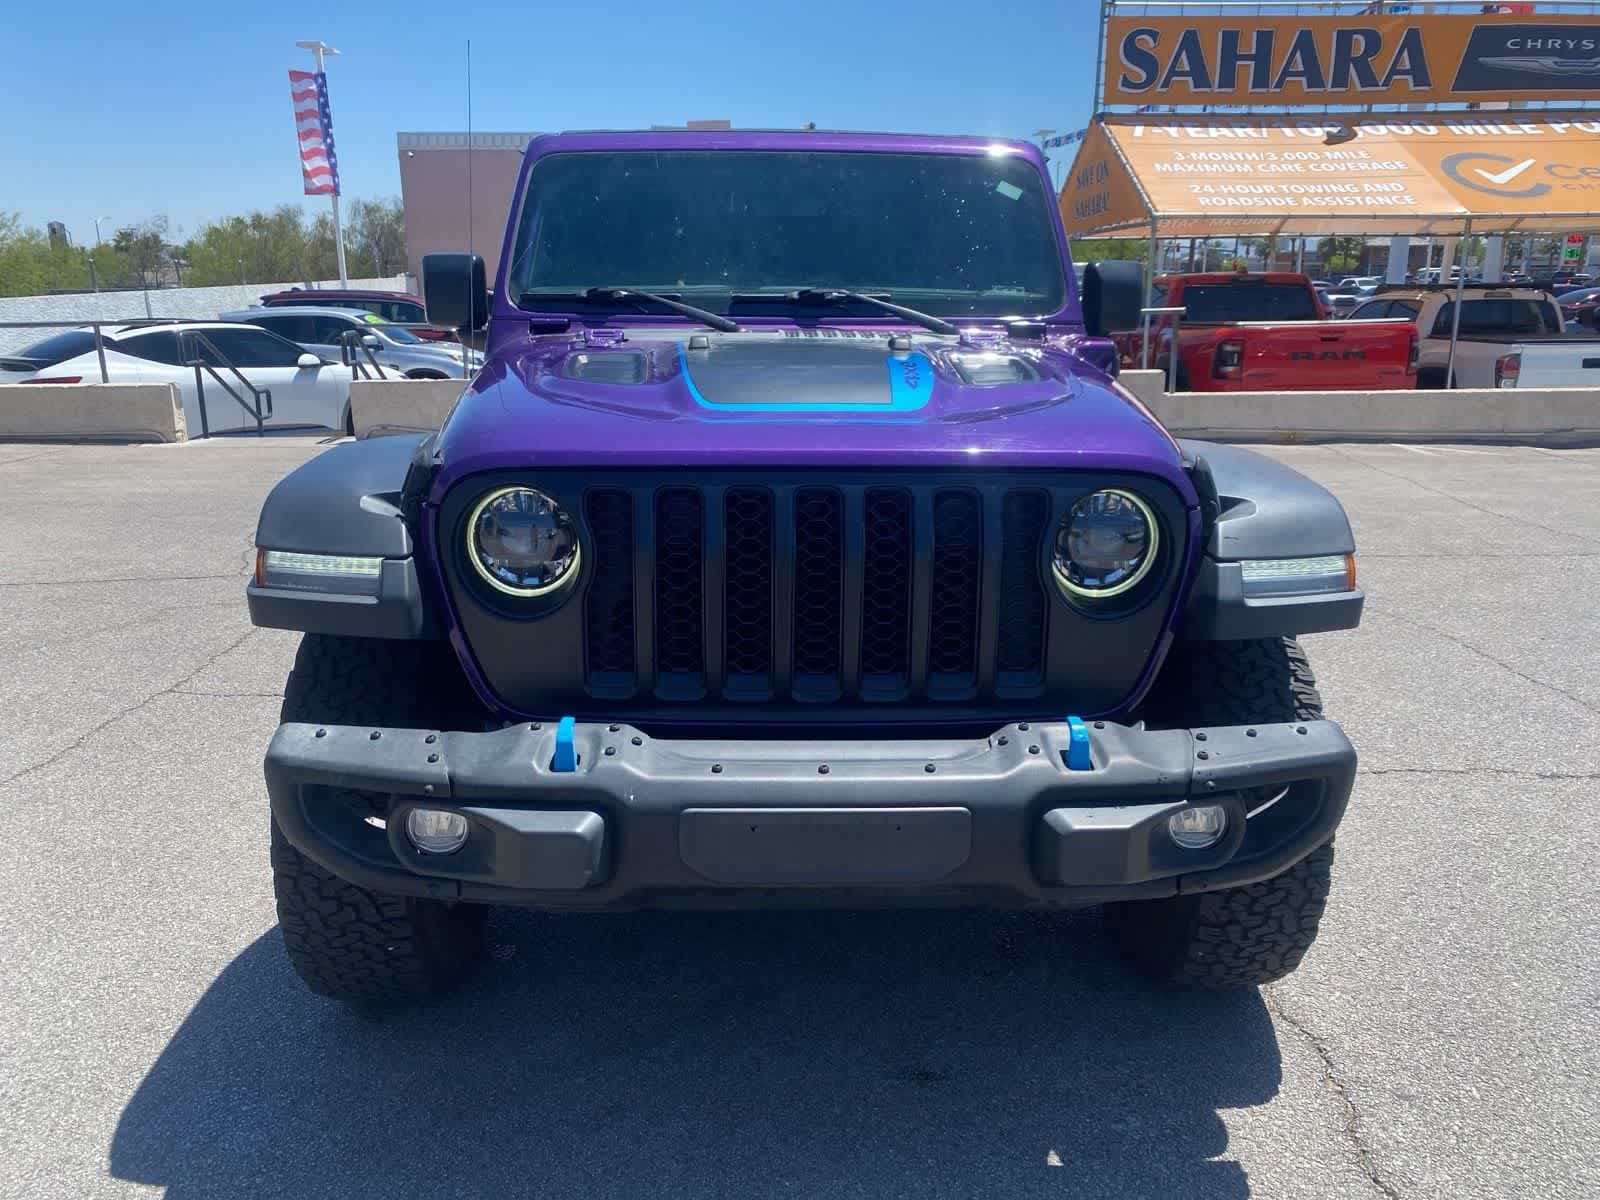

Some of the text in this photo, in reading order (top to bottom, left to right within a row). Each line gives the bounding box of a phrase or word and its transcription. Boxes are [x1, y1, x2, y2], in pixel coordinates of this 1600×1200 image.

[1506, 38, 1600, 50] CHRYS
[1117, 26, 1434, 93] SAHARA
[1443, 118, 1545, 136] MILE
[1173, 150, 1373, 162] 3-MONTH/3,000 MILE
[1154, 160, 1409, 174] MAXIMUM CARE COVERAGE
[1189, 182, 1406, 194] 24-HOUR TOWING AND
[1199, 195, 1417, 207] ROADSIDE ASSISTANCE
[1291, 350, 1368, 361] RAM
